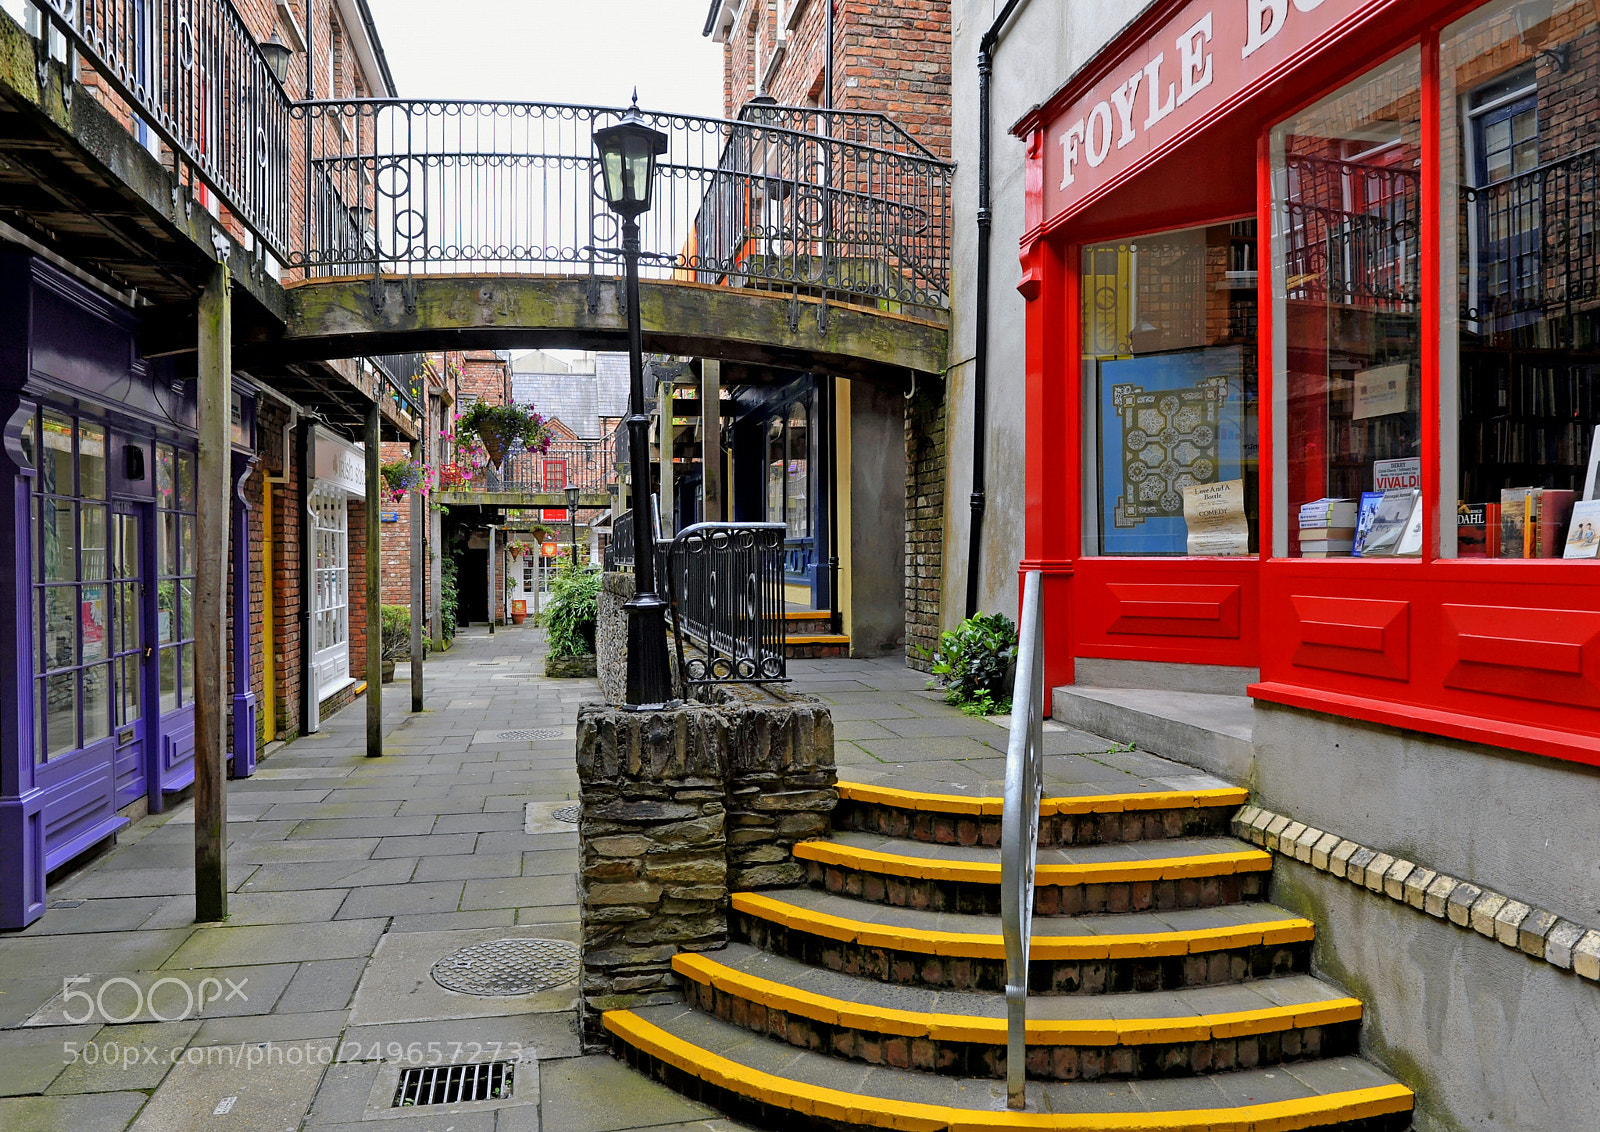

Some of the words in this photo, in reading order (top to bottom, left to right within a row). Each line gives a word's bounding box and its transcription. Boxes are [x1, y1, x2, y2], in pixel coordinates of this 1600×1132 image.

[1059, 11, 1213, 191] FOYLE
[1241, 0, 1326, 59] B
[1376, 475, 1420, 489] VIVALDI
[1210, 485, 1224, 493] And
[1198, 509, 1228, 517] COMEDY
[1457, 513, 1485, 524] DAHL
